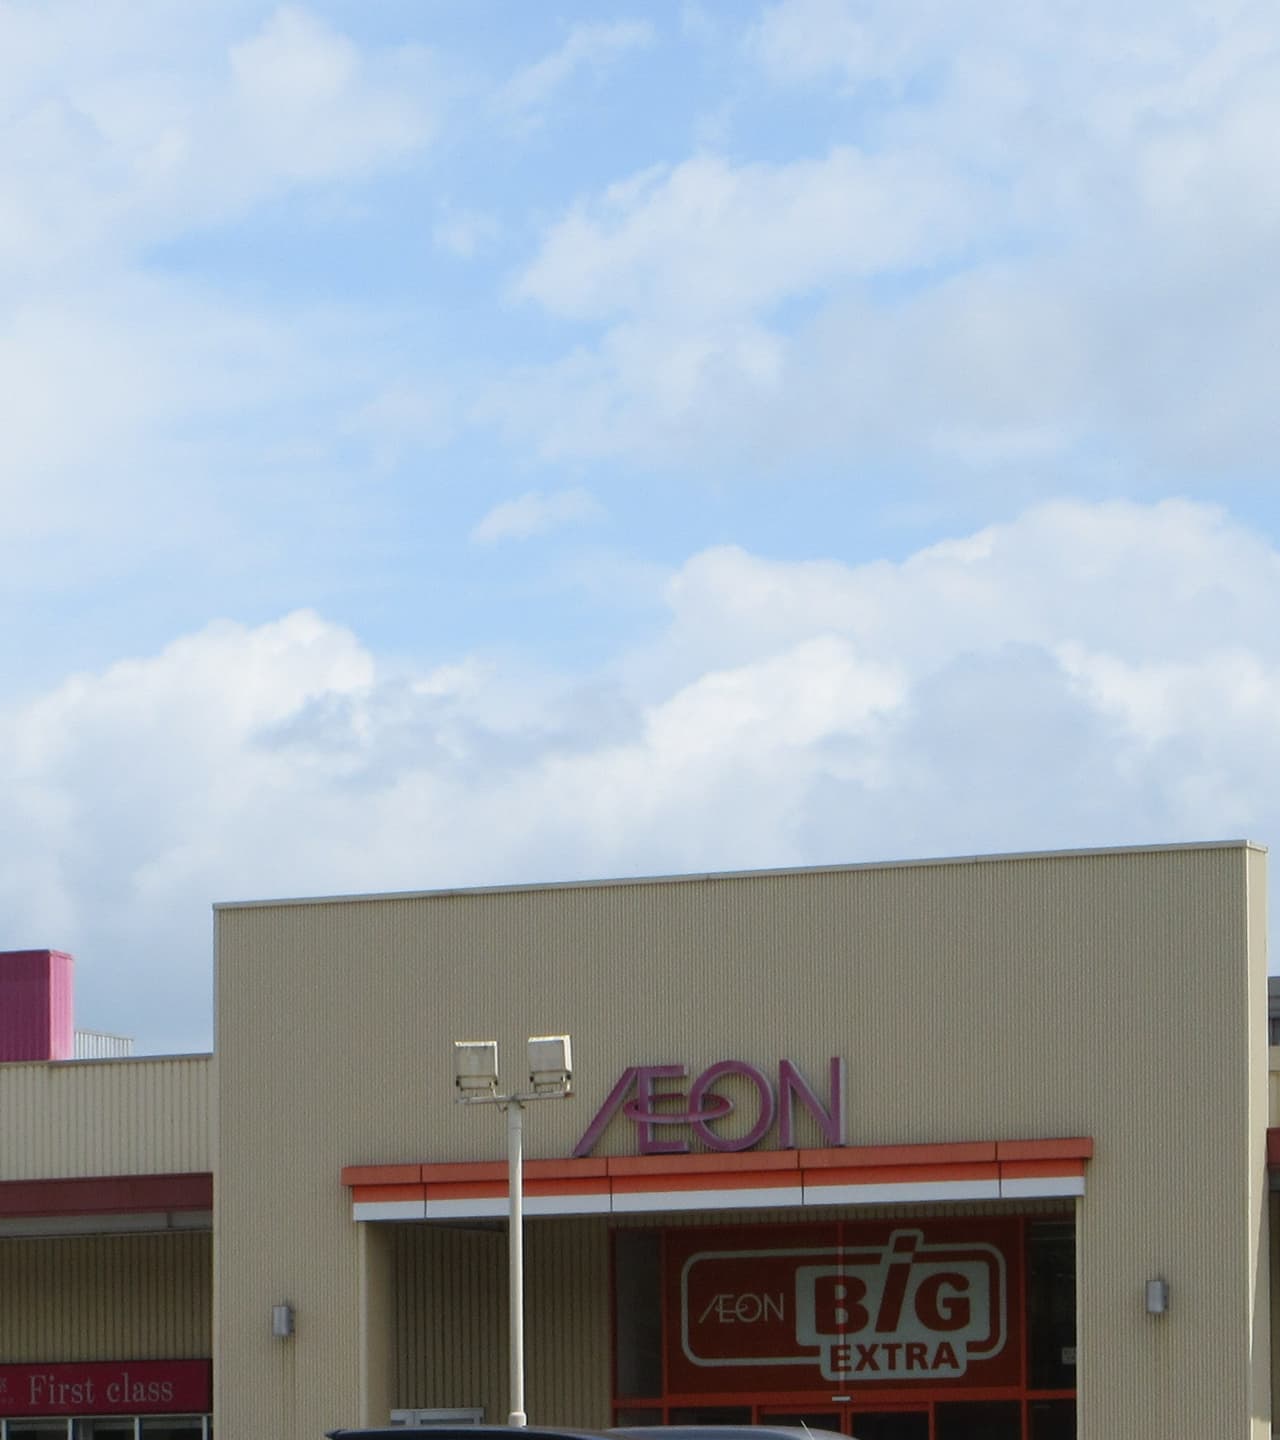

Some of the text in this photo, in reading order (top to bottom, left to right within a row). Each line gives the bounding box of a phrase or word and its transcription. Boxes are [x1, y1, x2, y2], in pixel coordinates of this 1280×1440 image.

[829, 1341, 961, 1373] EXTRA
[28, 1372, 174, 1405] First class
